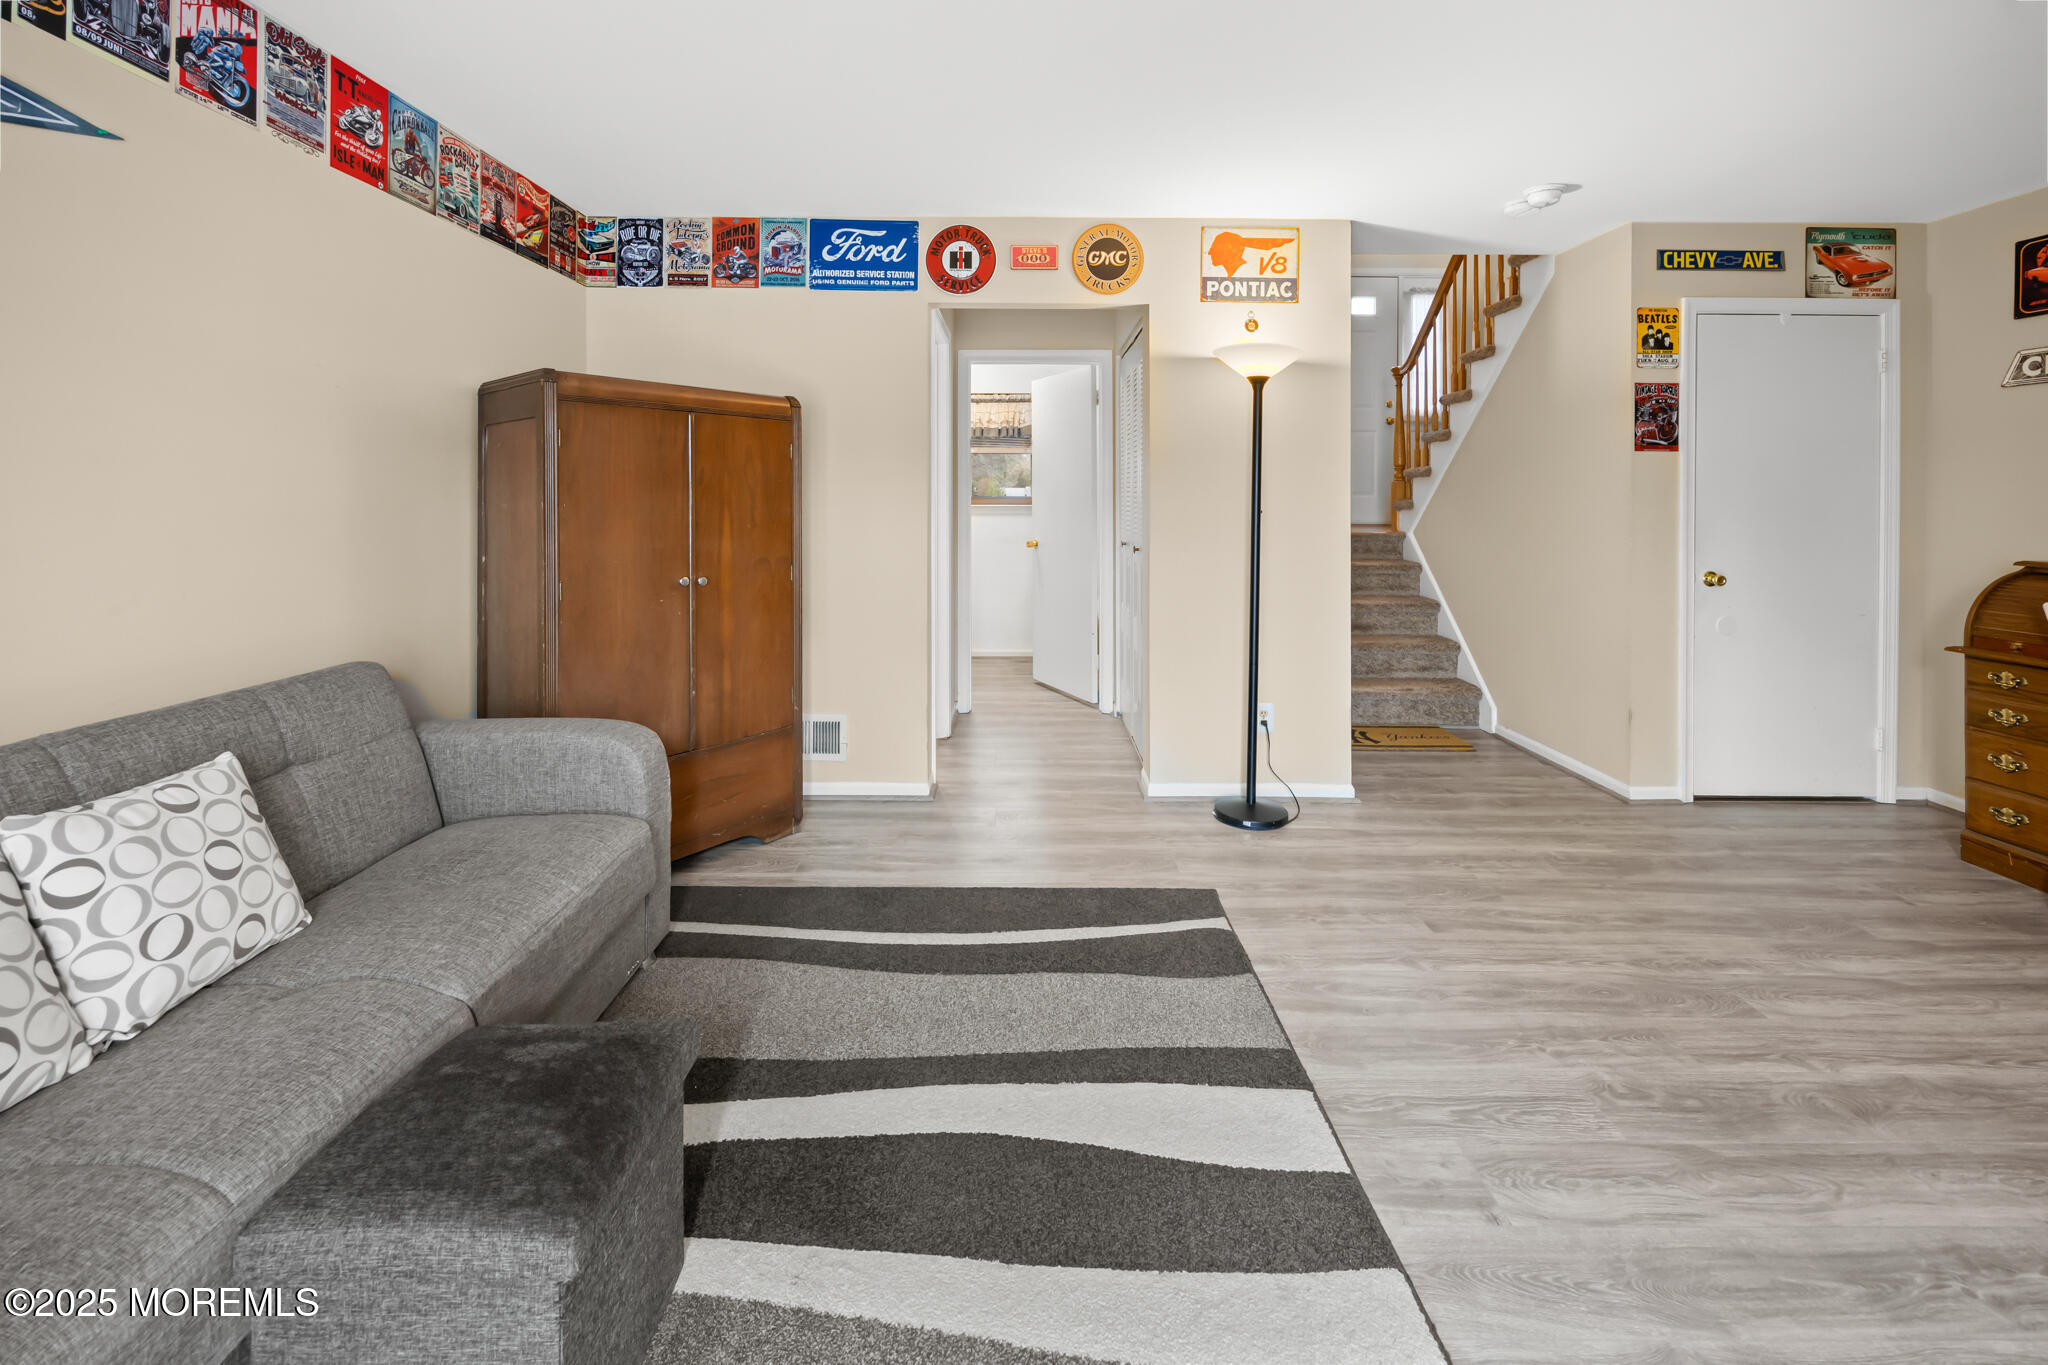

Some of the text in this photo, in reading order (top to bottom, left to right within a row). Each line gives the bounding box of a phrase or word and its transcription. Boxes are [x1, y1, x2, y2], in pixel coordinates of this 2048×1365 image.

[181, 5, 257, 39] MANIA
[104, 39, 123, 55] JUNI
[266, 22, 326, 69] Old Style
[333, 144, 385, 181] ISLE MAN
[439, 144, 479, 172] ROCKABILLY
[454, 159, 467, 172] DAY
[620, 226, 662, 242] RIDE OR DIE
[716, 222, 756, 242] COMMON
[1811, 231, 1846, 243] Plymouth
[716, 236, 756, 253] GROUND
[822, 228, 908, 263] Ford
[930, 229, 992, 257] MOTOR TRUCK
[1076, 228, 1139, 268] GENERAL MOTORS
[1088, 250, 1127, 267] GMC
[1259, 251, 1288, 276] V8
[1663, 251, 1779, 269] CHEVY AVE.
[764, 265, 802, 275] MOTORAMA
[812, 269, 915, 279] AUTHORIZED SERVICE STATION
[937, 273, 983, 291] SERVICE
[1086, 275, 1131, 291] TRUCKS
[1206, 280, 1293, 298] PONTIAC
[1637, 313, 1678, 324] BEATLES
